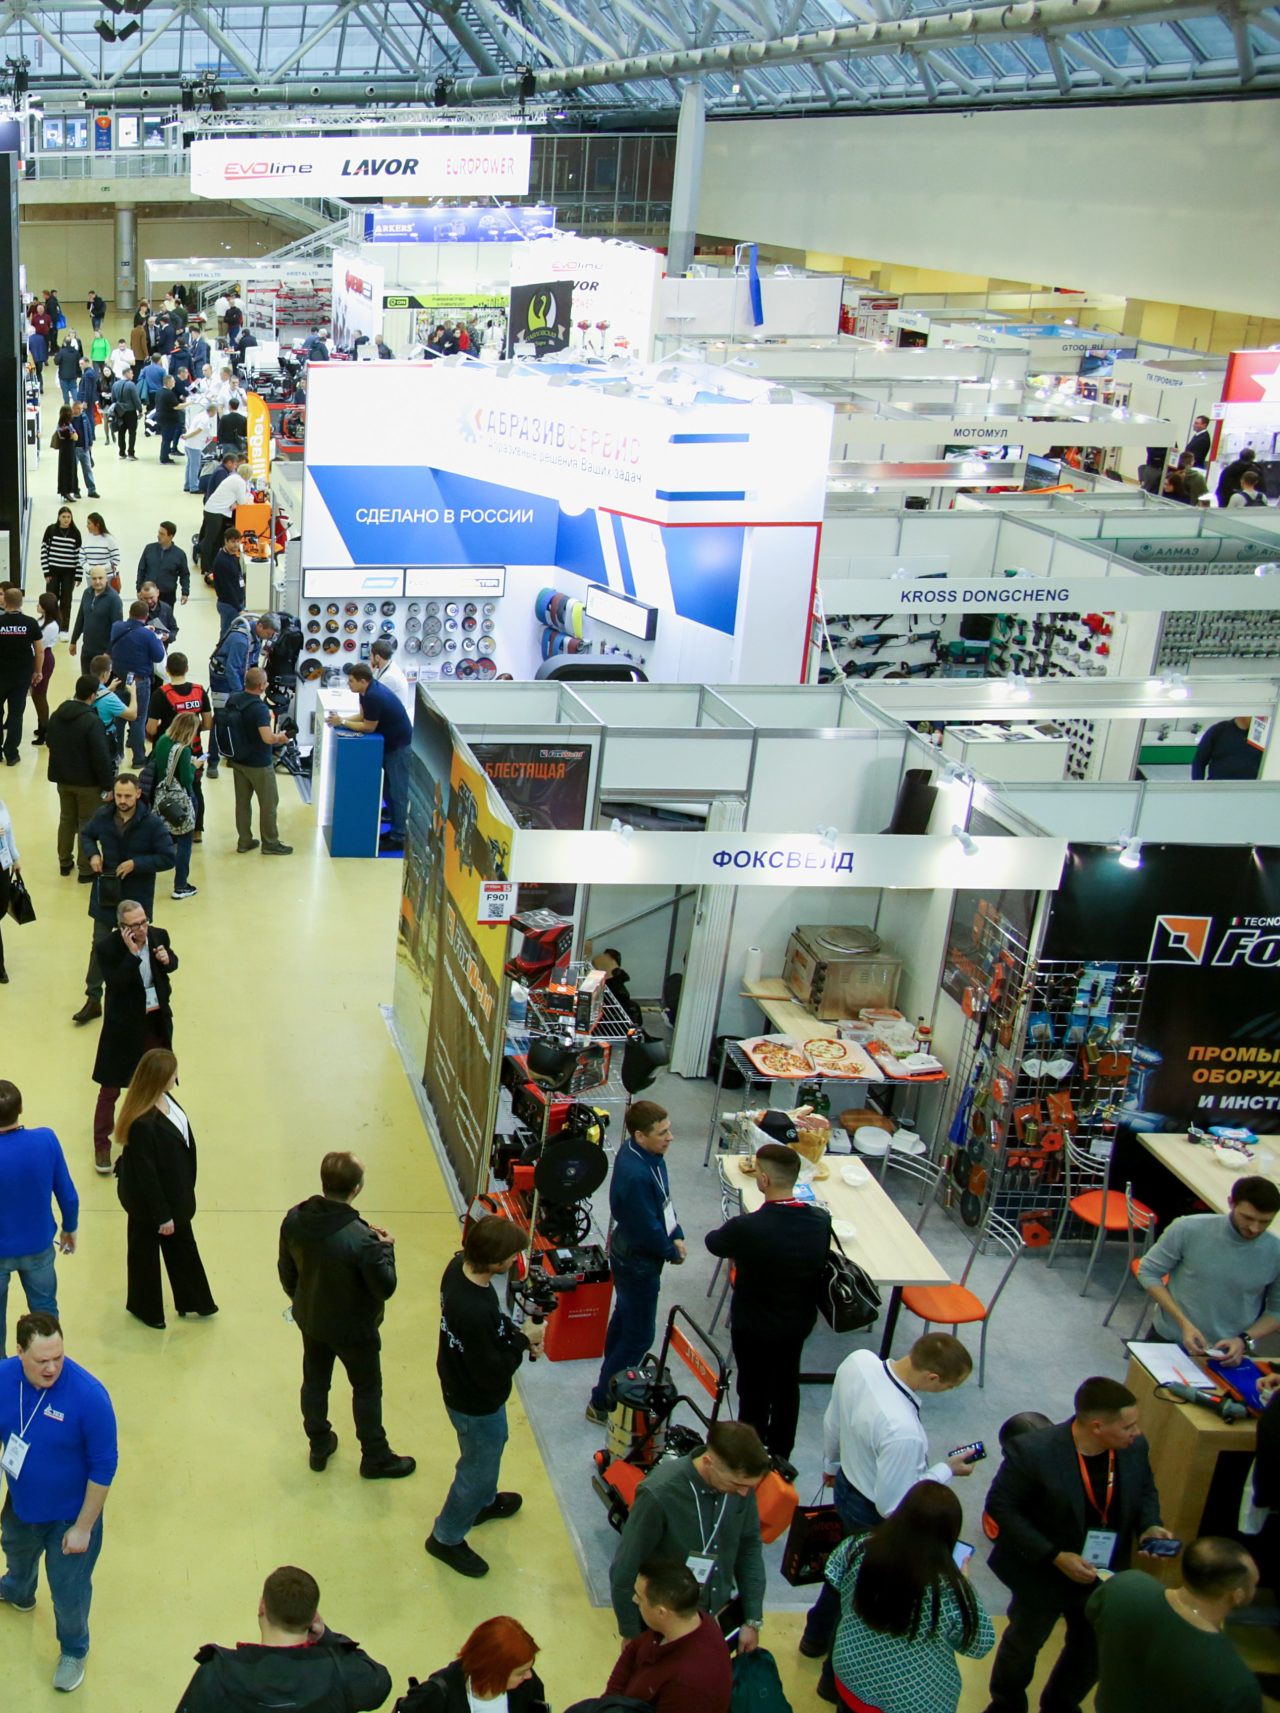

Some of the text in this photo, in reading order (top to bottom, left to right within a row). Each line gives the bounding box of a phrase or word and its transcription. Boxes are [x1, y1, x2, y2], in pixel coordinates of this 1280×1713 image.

[224, 162, 312, 175] EVOline
[341, 159, 419, 176] LAVOR
[446, 157, 515, 175] EUROPOWER
[571, 281, 599, 291] VOR
[953, 427, 1008, 438] МОТОМУЛ
[614, 469, 642, 484] задач
[356, 508, 534, 525] СДЕЛАНО В РОССИИ
[1155, 547, 1200, 556] АЛМАЗ
[900, 588, 1070, 603] KROSS DONGCHENG
[485, 763, 566, 779] БЛЕСТЯЩАЯ
[712, 850, 854, 873] ФОКСВЕЛД
[486, 893, 508, 901] F901
[1187, 1046, 1280, 1063] ПРОМЫ
[1198, 1095, 1280, 1110] И ИНСТ
